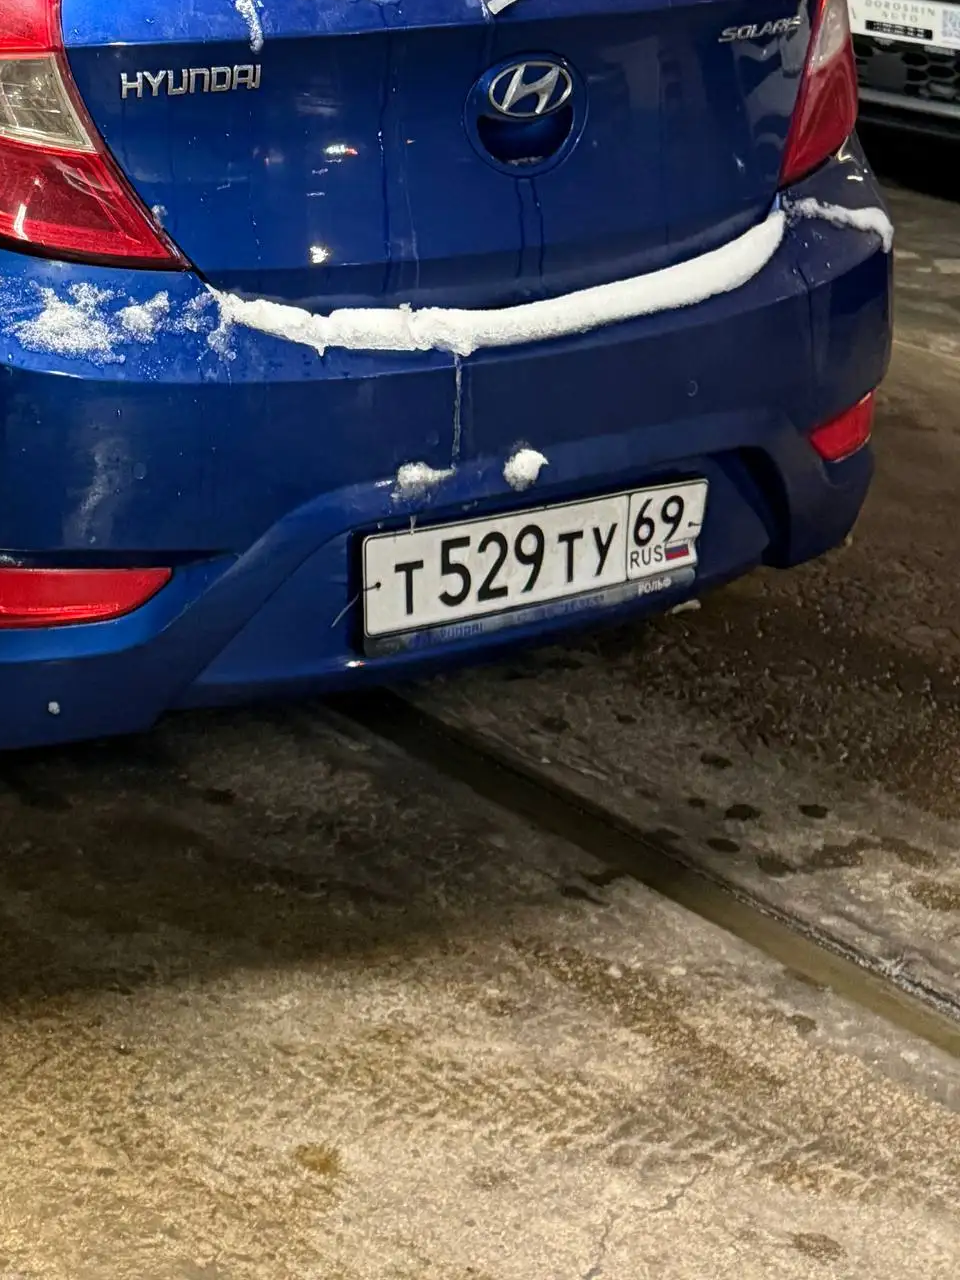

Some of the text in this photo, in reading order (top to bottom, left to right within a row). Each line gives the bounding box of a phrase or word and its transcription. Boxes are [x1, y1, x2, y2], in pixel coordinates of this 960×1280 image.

[120, 64, 262, 99] HYUNDAI
[633, 495, 685, 547] 69
[630, 544, 663, 570] RUS
